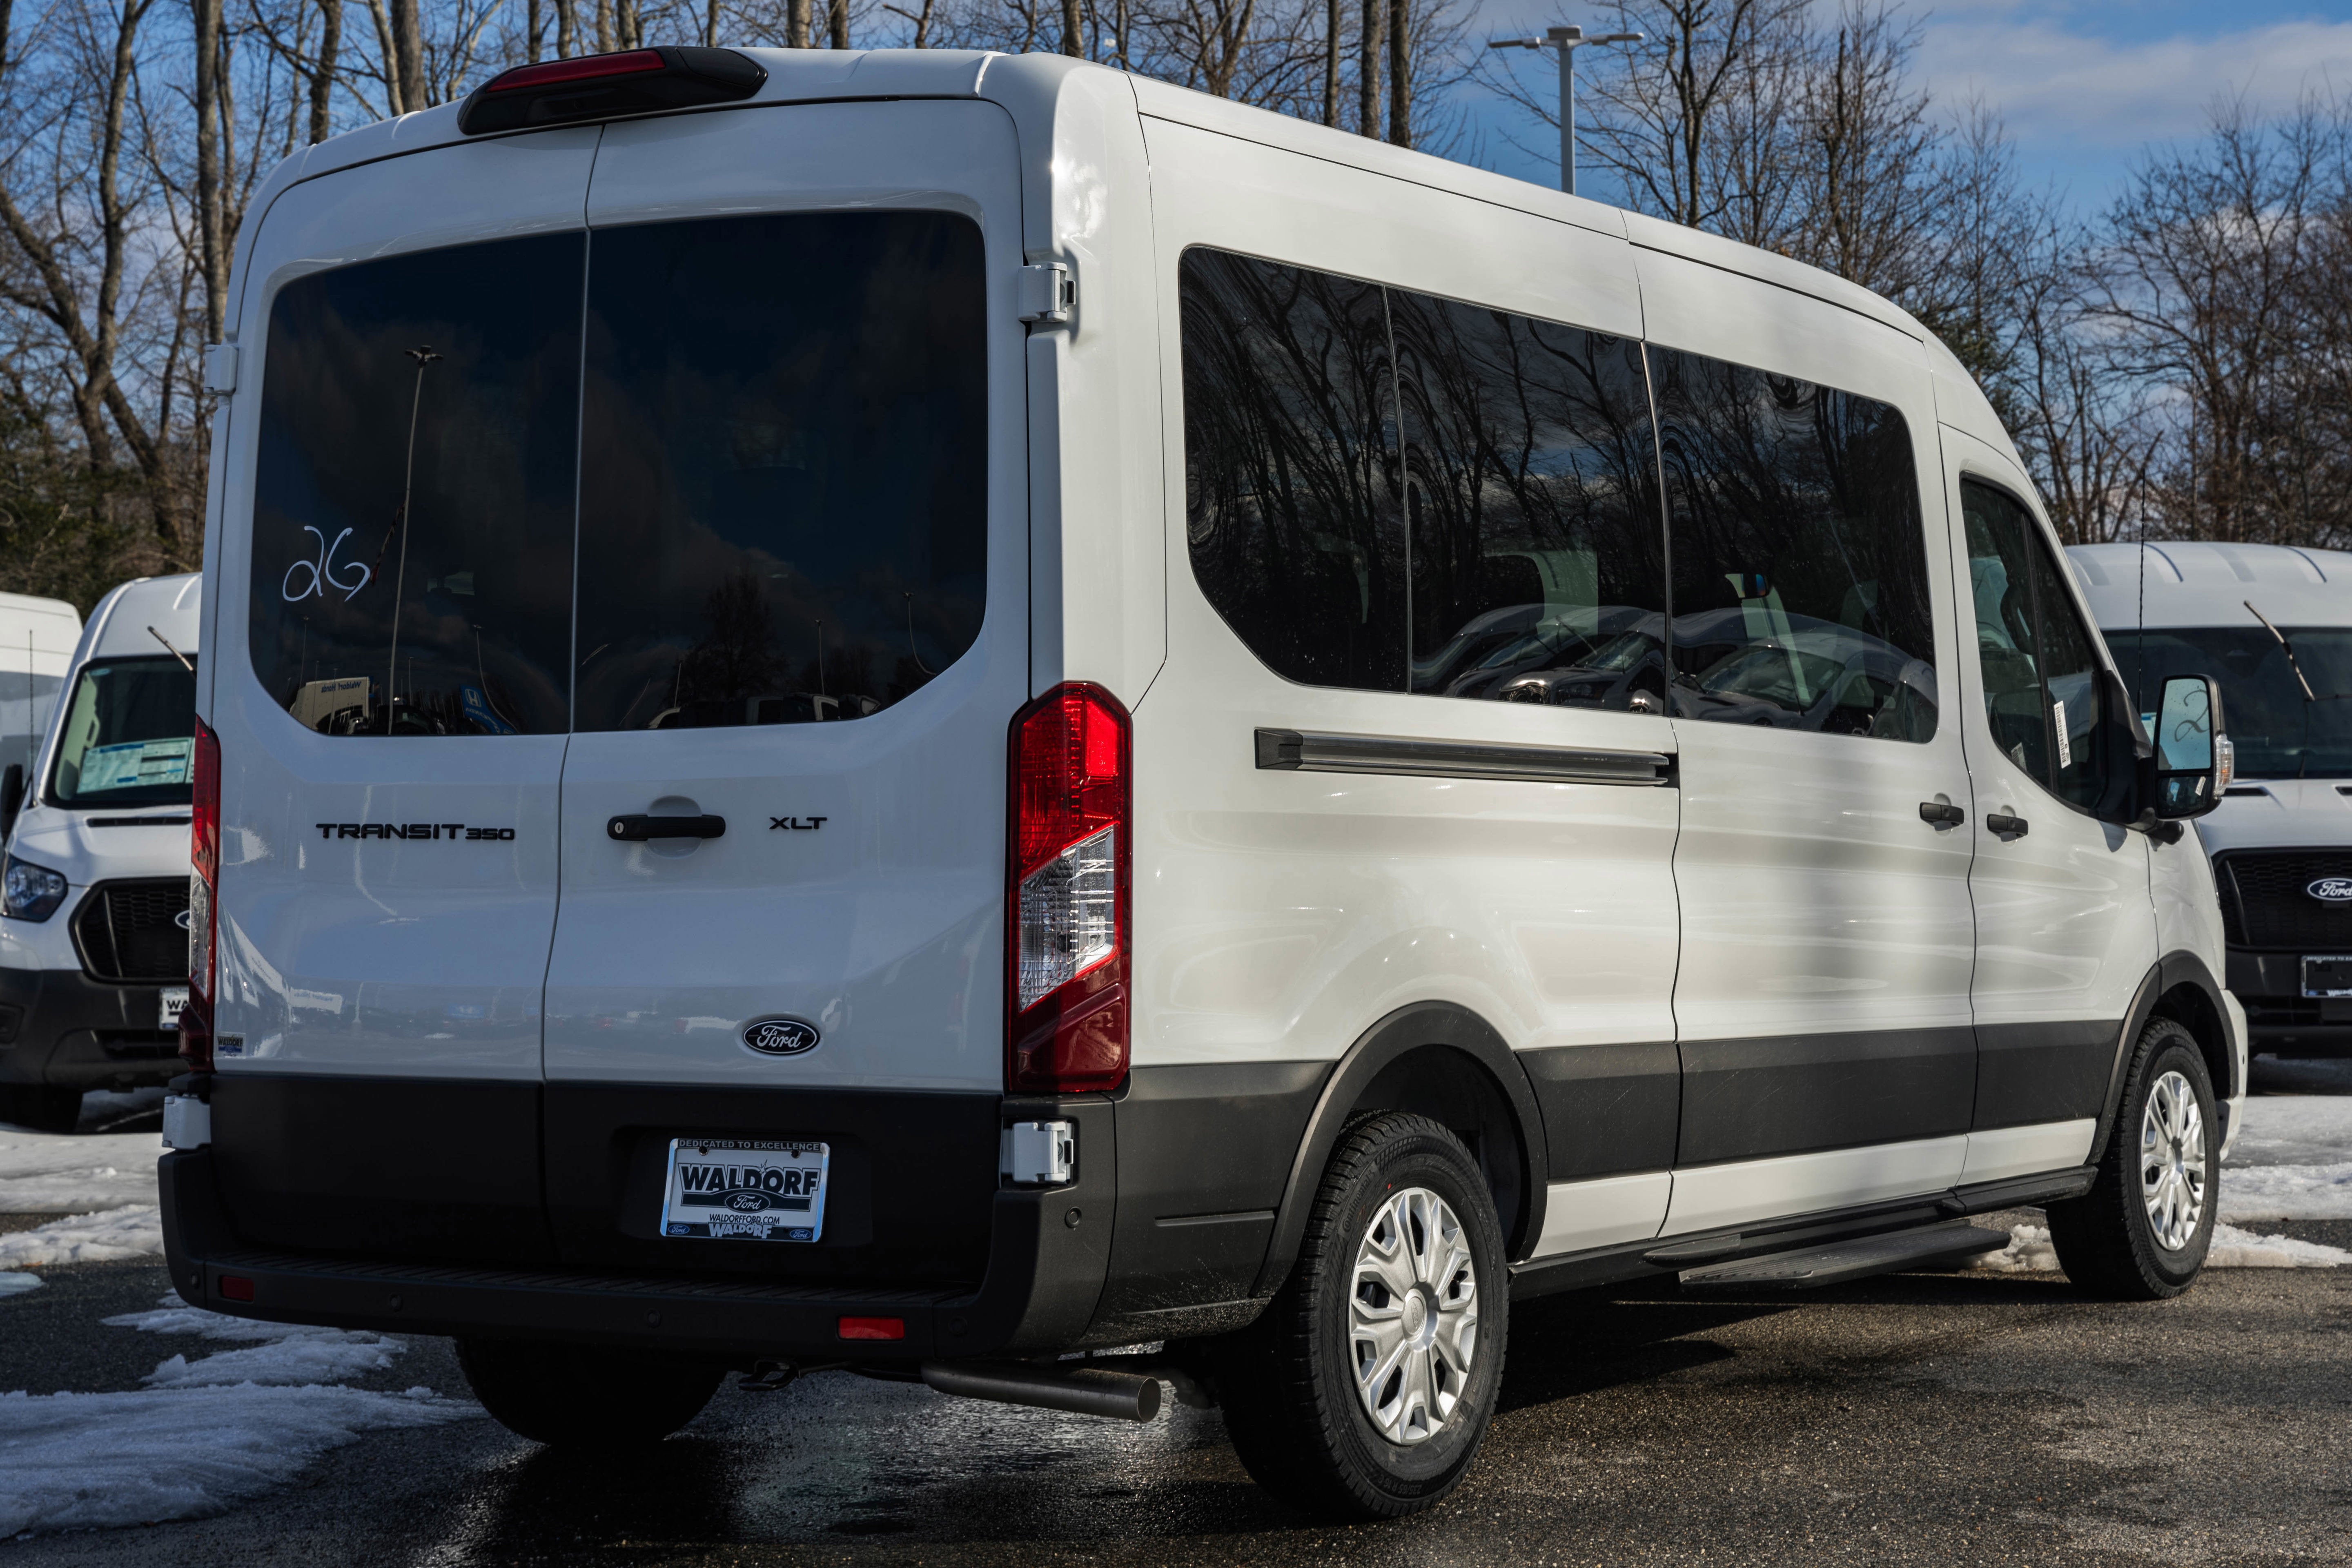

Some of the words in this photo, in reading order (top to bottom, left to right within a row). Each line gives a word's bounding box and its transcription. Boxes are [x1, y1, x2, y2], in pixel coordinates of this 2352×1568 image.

[769, 817, 827, 830] XLT
[757, 1025, 802, 1048] Ford
[679, 1139, 734, 1148] DEDICATED
[754, 1142, 820, 1151] EXCELLENCE
[679, 1163, 821, 1196] WALDORF
[733, 1195, 760, 1210] Ford
[709, 1213, 780, 1225] WALDORFFORD.COM
[708, 1222, 773, 1239] WALDORF
